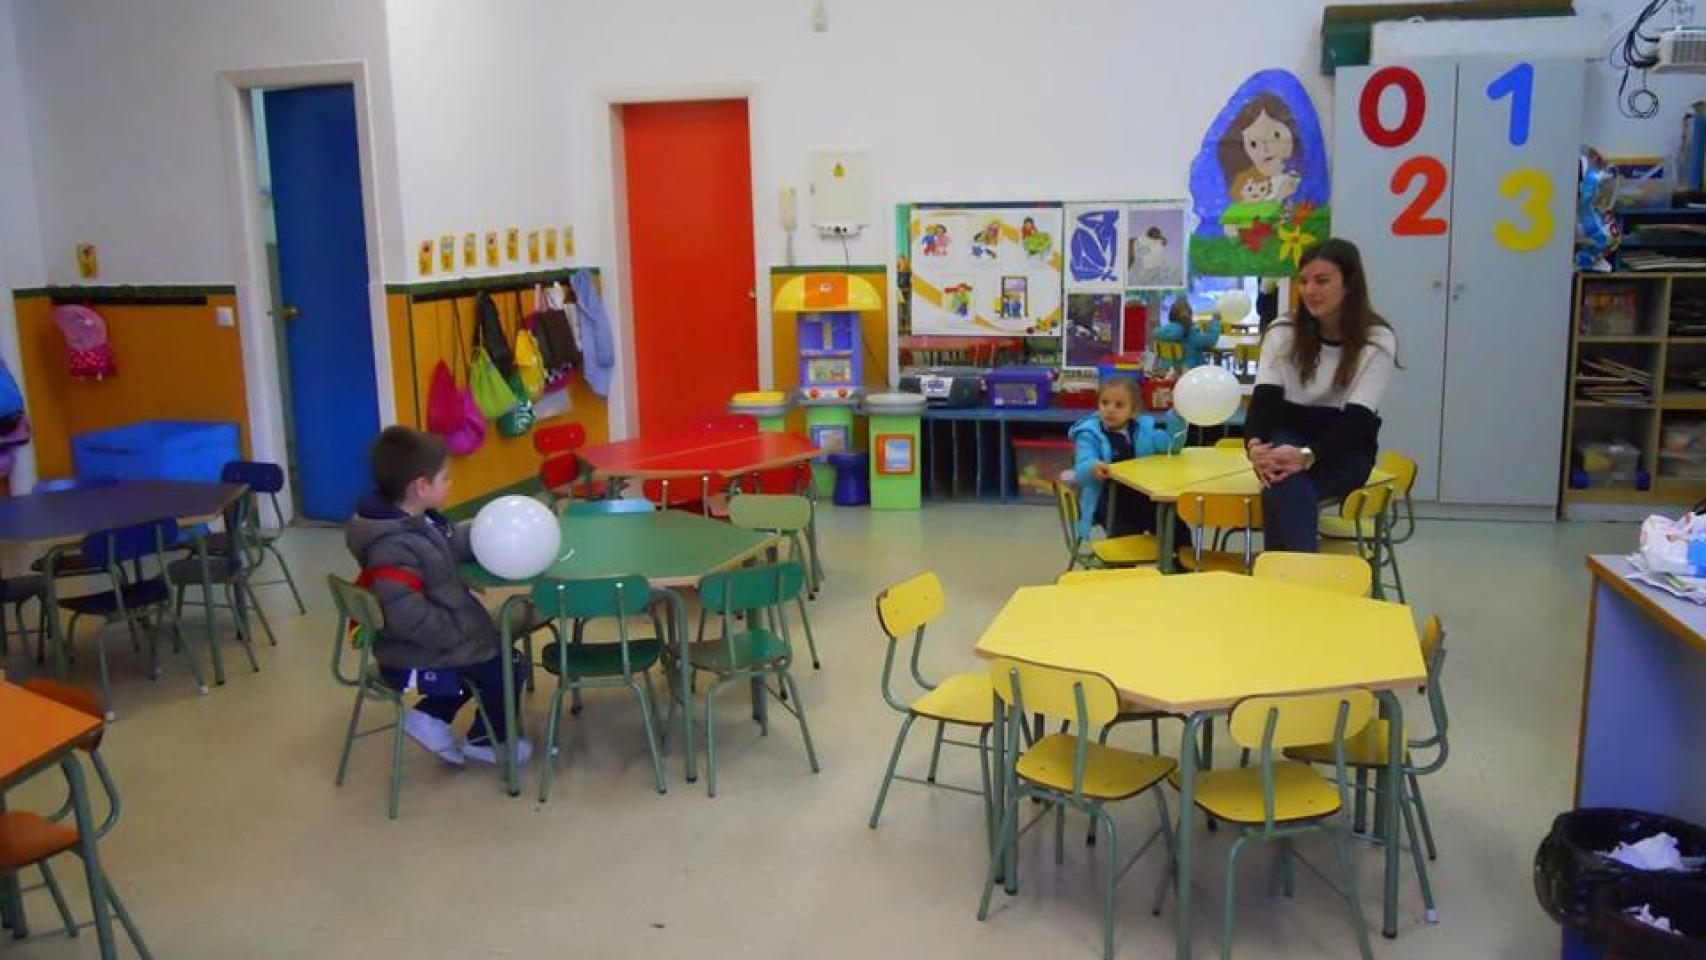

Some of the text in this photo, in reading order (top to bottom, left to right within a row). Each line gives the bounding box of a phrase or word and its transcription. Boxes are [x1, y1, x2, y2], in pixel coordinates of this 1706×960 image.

[1359, 66, 1426, 147] 0
[1487, 62, 1535, 146] 1
[1391, 156, 1447, 236] 2
[1494, 169, 1555, 252] 3
